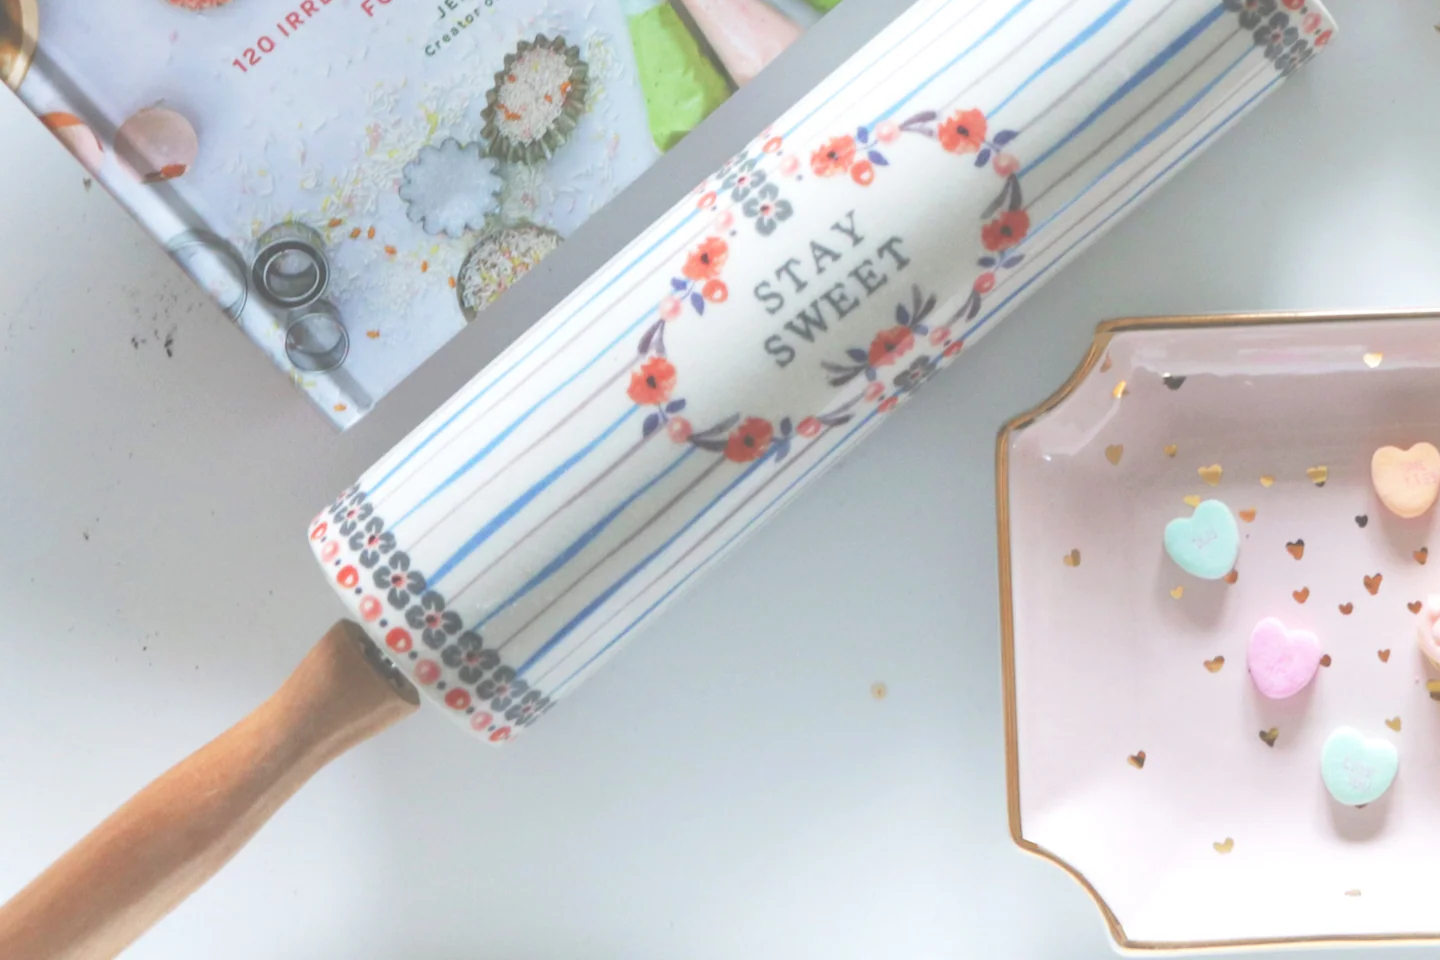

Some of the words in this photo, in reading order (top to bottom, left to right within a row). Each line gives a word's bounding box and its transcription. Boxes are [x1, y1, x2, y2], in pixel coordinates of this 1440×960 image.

[233, 36, 276, 72] 120
[425, 7, 480, 57] Creator
[754, 210, 865, 315] STAY
[764, 236, 910, 368] SWEET
